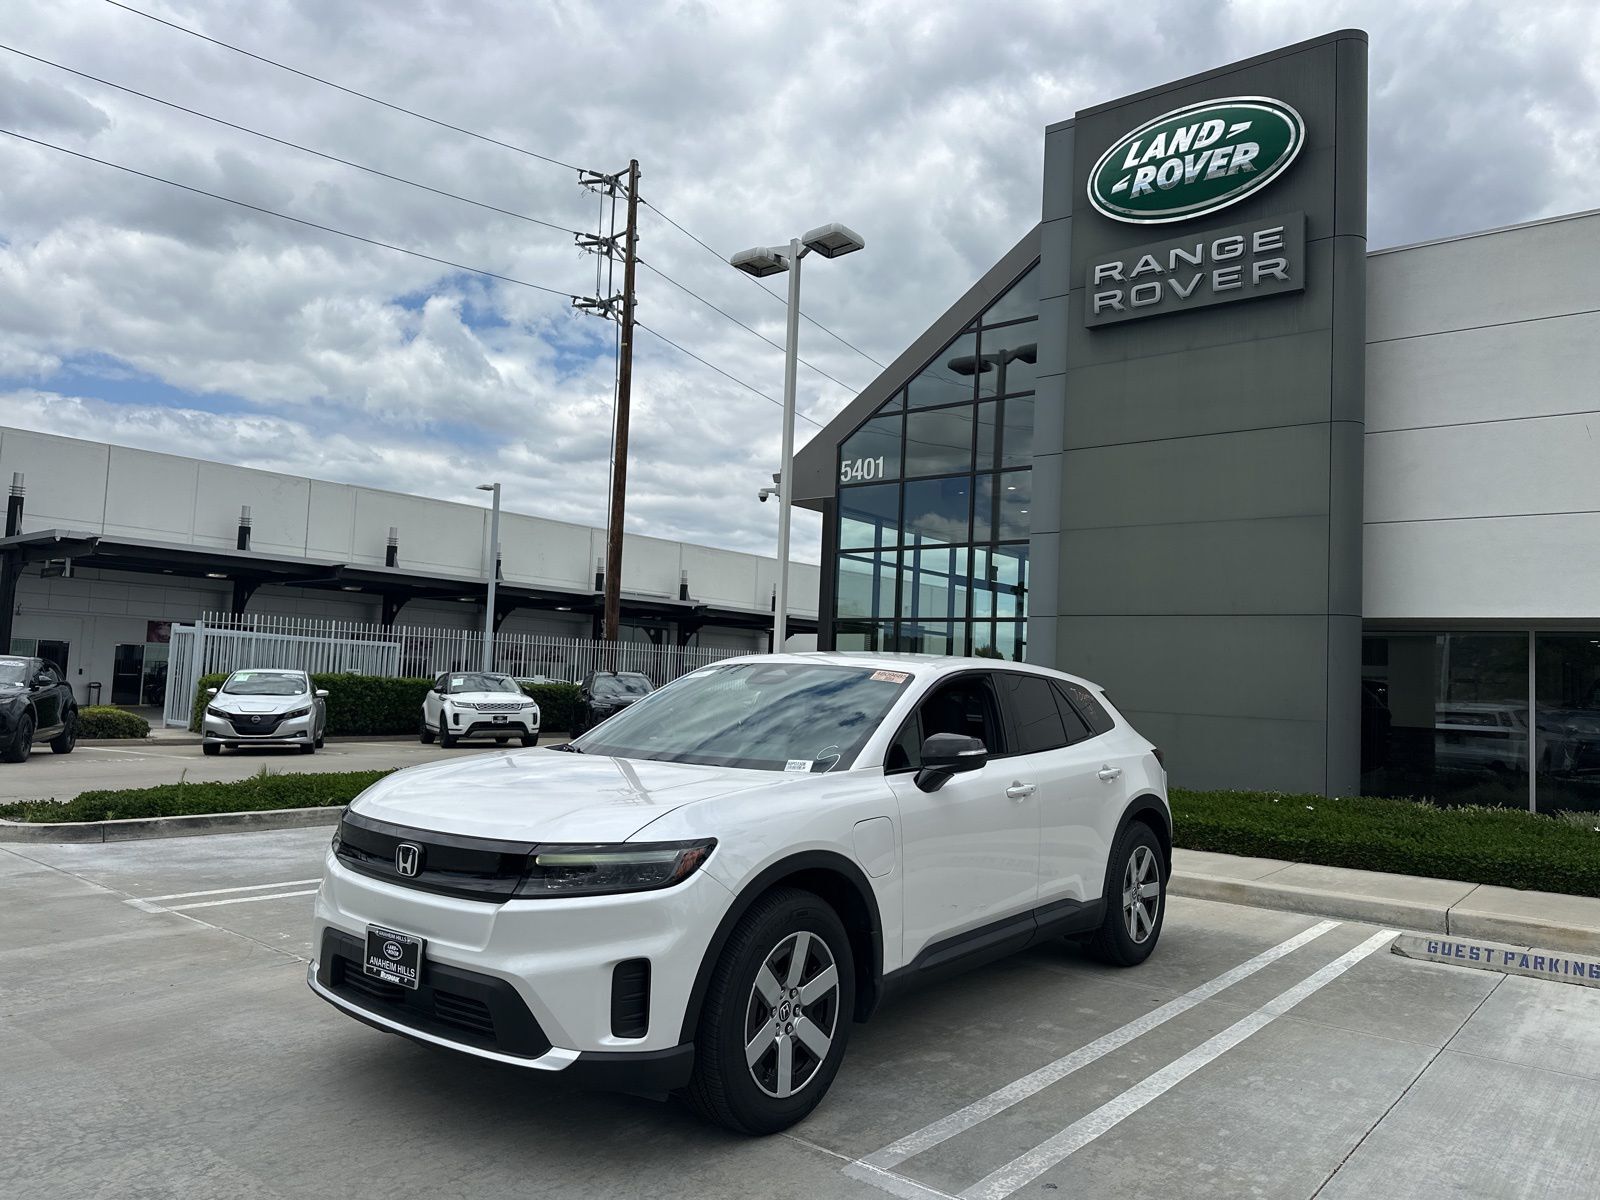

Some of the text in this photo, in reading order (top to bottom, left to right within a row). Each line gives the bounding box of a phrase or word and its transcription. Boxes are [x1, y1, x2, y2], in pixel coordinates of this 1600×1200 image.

[1129, 142, 1260, 199] ROVER
[1093, 226, 1285, 286] RANGE
[1093, 257, 1291, 314] ROVER
[840, 455, 885, 482] 5401
[369, 955, 416, 978] ANAHEIM HILLS
[1427, 940, 1600, 980] GUEST PARKING
